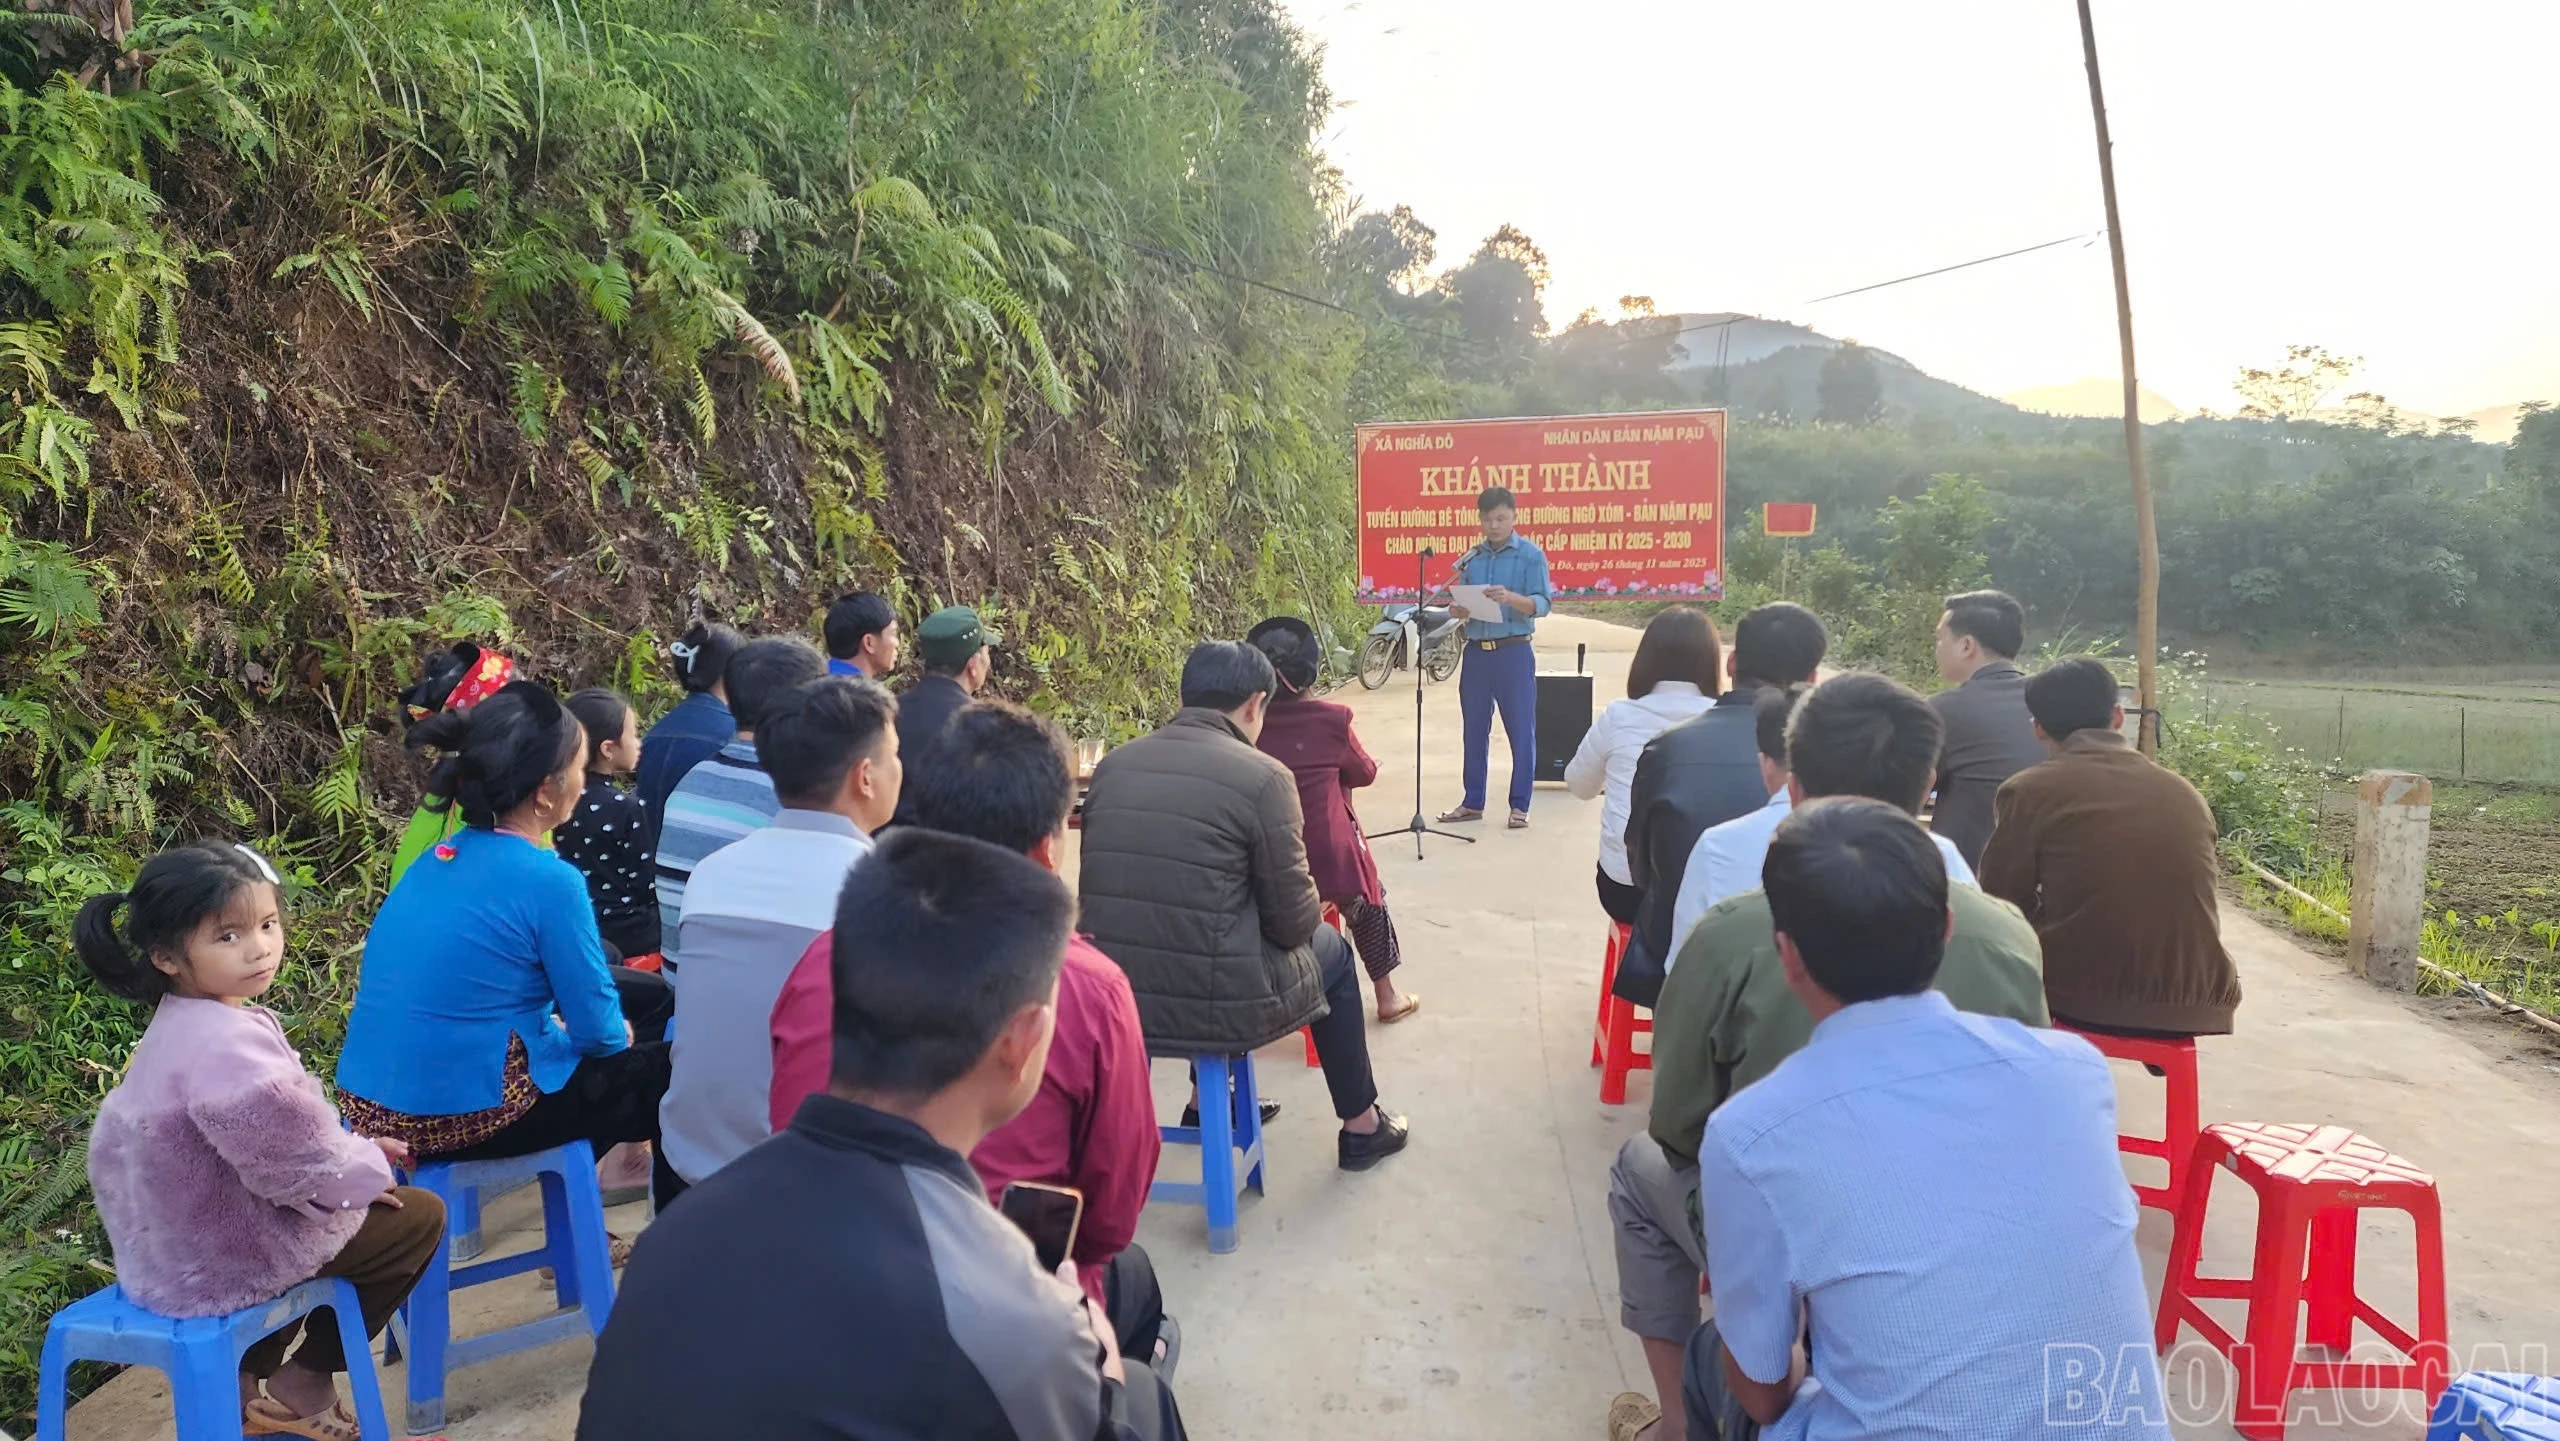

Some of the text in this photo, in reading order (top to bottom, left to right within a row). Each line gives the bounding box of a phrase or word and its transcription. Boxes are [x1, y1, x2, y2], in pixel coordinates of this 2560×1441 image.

[1395, 434, 1433, 450] NGHĨA
[1544, 429, 1580, 445] NHÂN
[1582, 428, 1611, 444] DÂN
[1613, 424, 1641, 442] BẢN
[1420, 453, 1652, 496] KHÁNH THÀNH
[1400, 506, 1436, 528] ĐƯỜNG
[1598, 502, 1624, 523] XÓM
[1633, 498, 1658, 522] BẢN
[1626, 532, 1654, 550] 2025
[1663, 531, 1692, 549] 2030
[1600, 560, 1614, 569] 26
